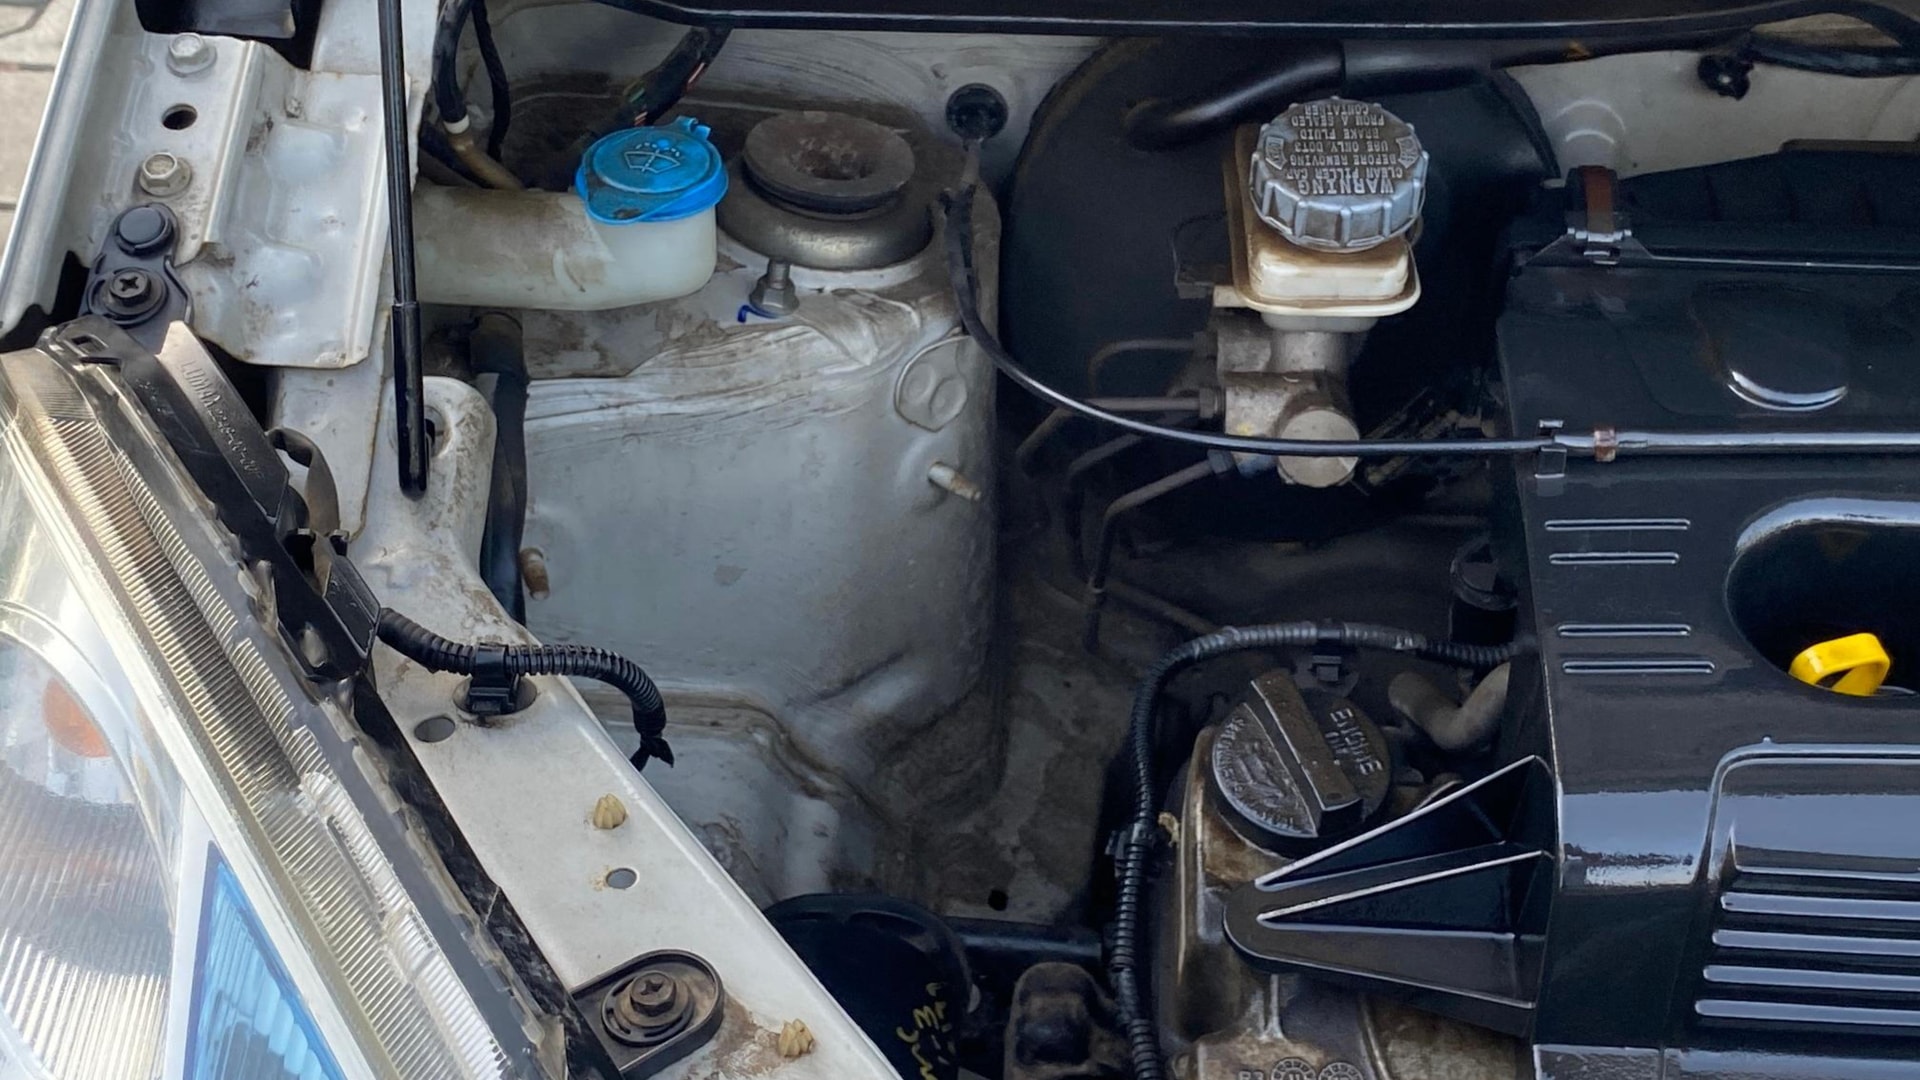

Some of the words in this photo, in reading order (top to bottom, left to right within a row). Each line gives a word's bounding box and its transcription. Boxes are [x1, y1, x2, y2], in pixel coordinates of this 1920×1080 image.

[1304, 104, 1369, 116] CONTAINER
[1291, 115, 1334, 127] SEALED
[1341, 115, 1349, 126] A
[1355, 115, 1385, 126] FROM
[1299, 128, 1336, 140] FLUID
[1343, 128, 1379, 139] BRAKE
[1330, 140, 1360, 153] ONLY
[1366, 141, 1389, 153] USE
[1290, 154, 1348, 166] REMOVING
[1353, 153, 1397, 166] BEFORE
[1315, 167, 1359, 180] FILLER
[1366, 167, 1403, 179] CLEAN
[1297, 177, 1394, 195] WARNING
[1329, 708, 1384, 776] ENGINE
